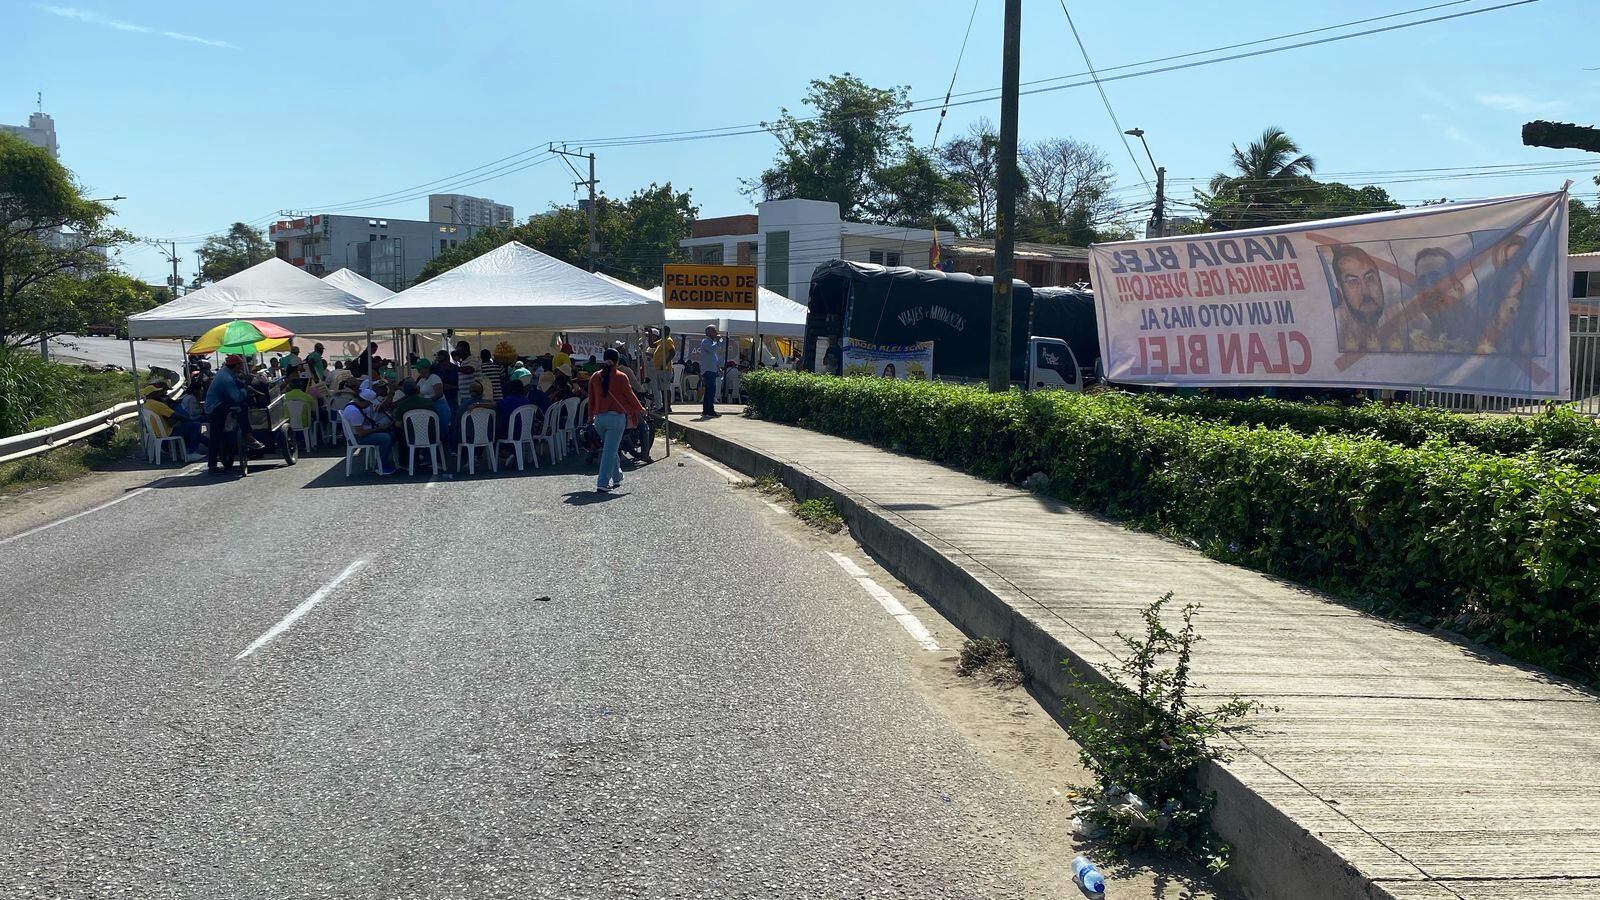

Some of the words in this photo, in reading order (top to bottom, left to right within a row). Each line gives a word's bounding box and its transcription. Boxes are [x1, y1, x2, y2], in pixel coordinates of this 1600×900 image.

[666, 273, 730, 287] PELIGRO
[735, 275, 755, 288] DE
[669, 289, 753, 303] ACCIDENTE
[897, 305, 924, 327] VIAJES
[929, 304, 967, 332] MUDANZAS
